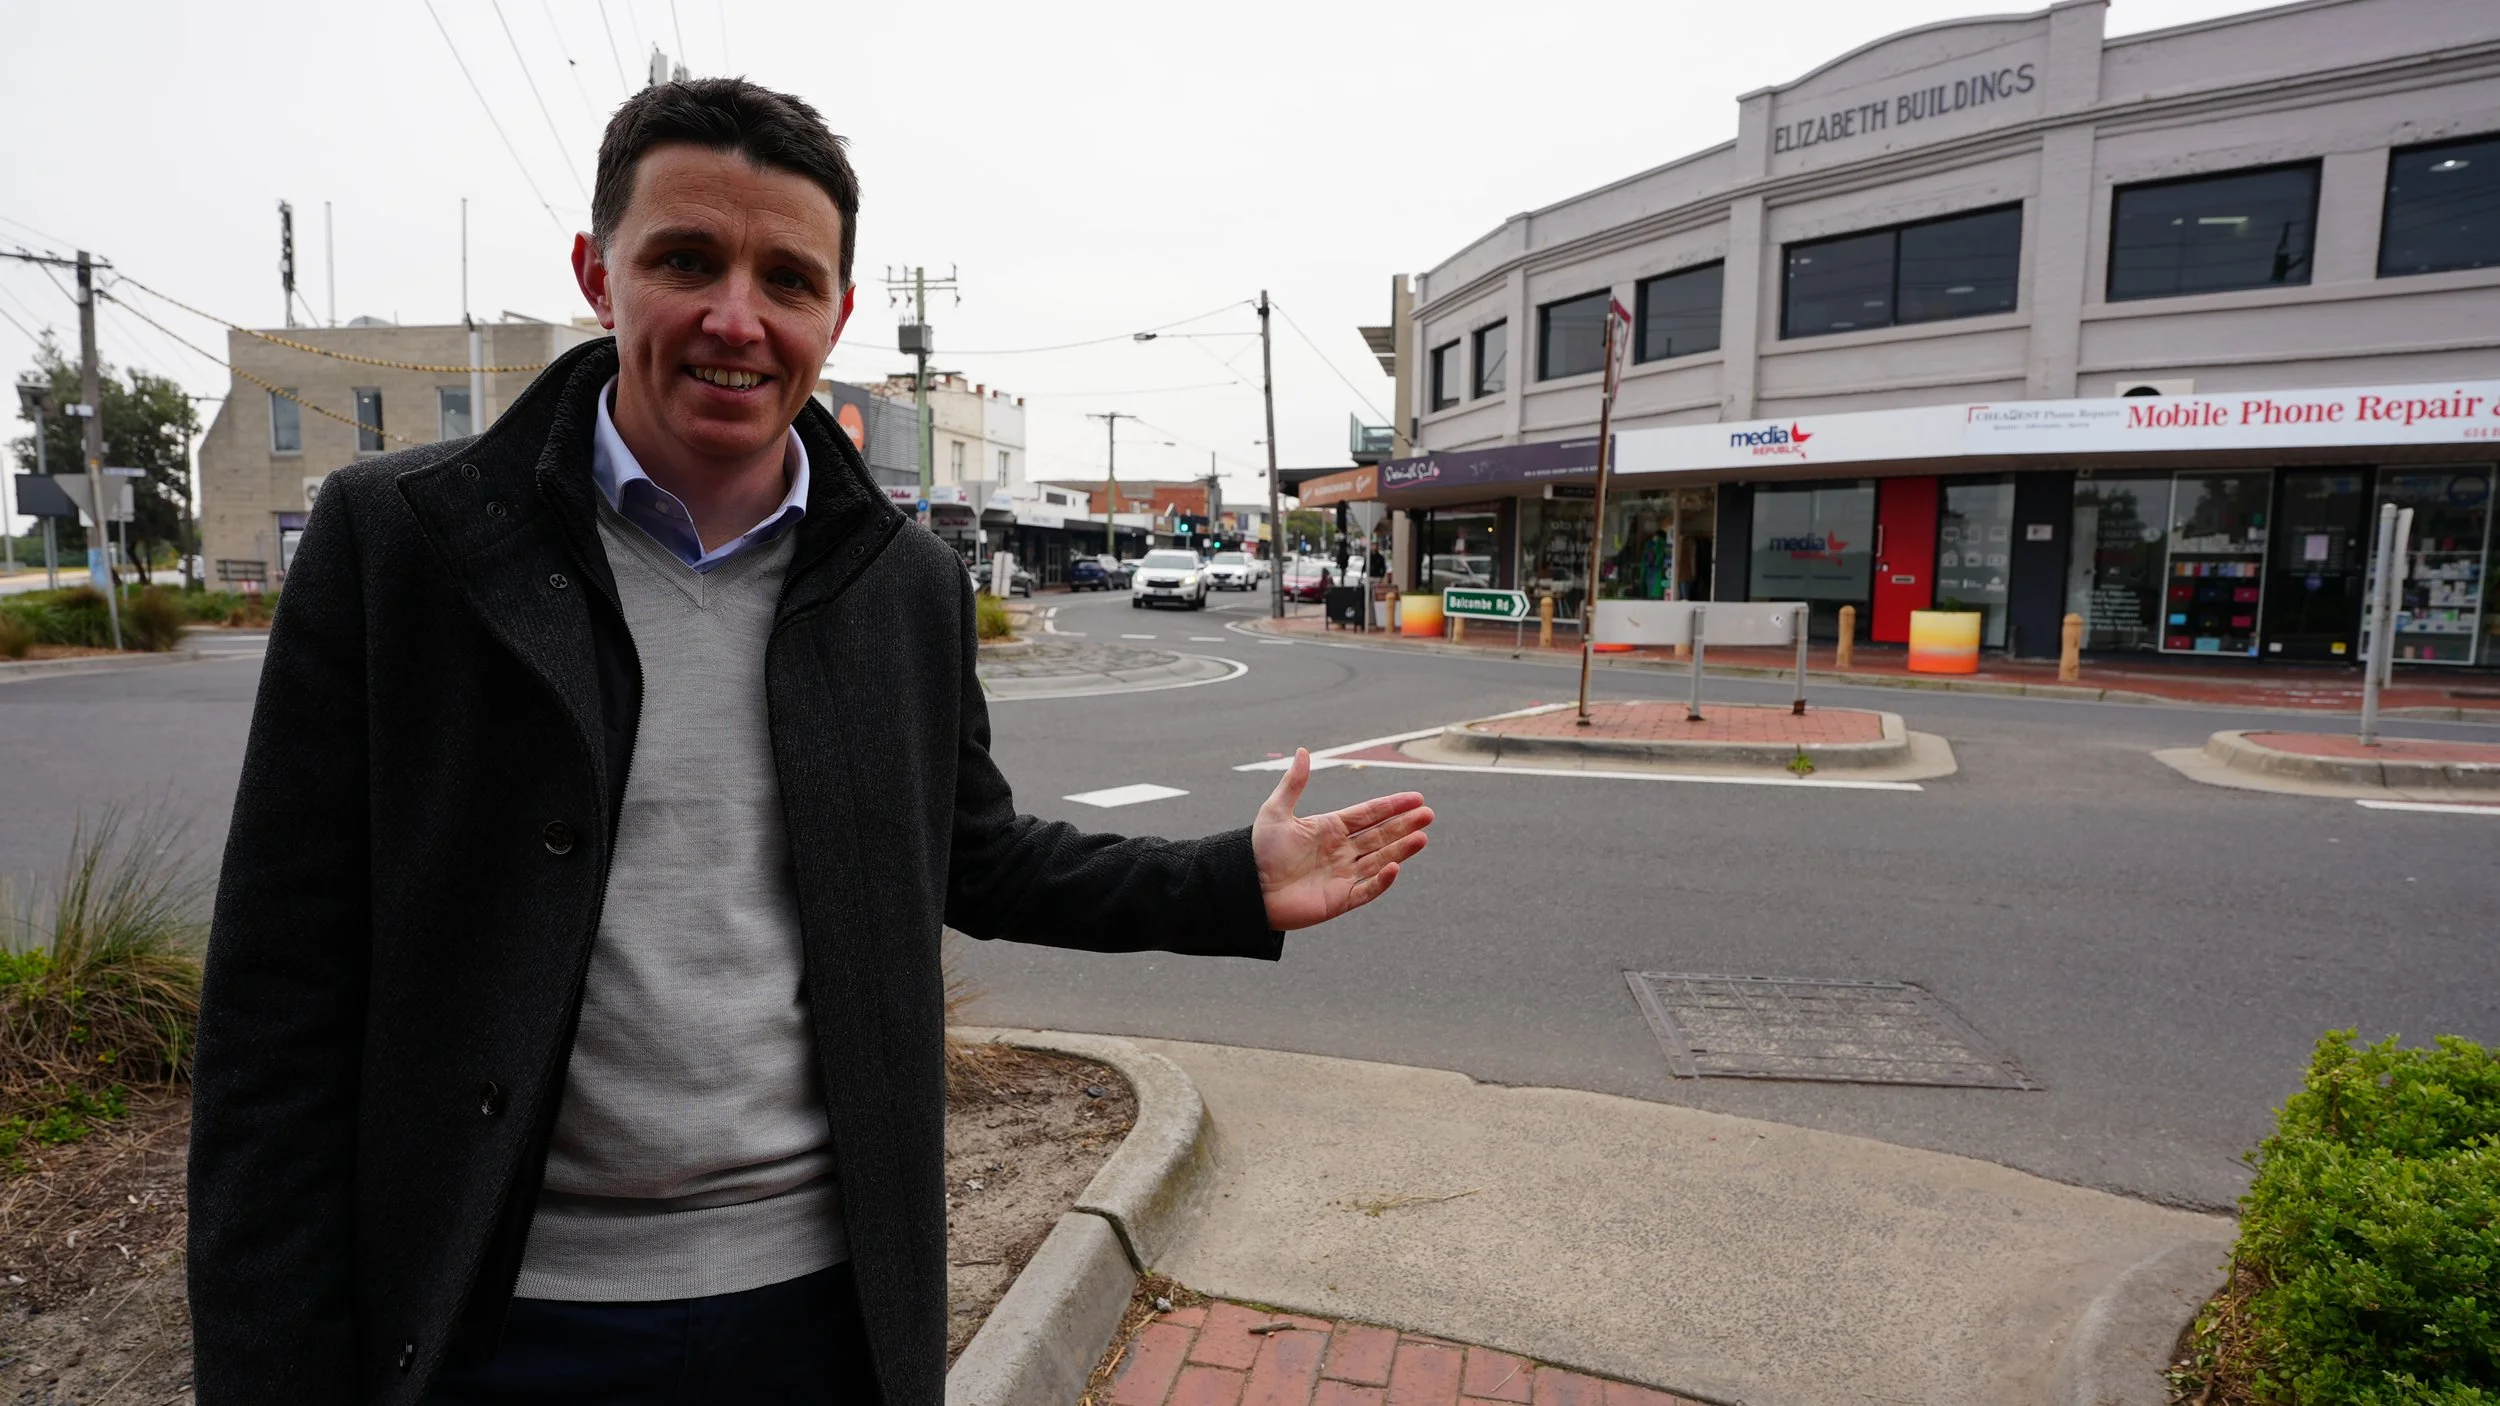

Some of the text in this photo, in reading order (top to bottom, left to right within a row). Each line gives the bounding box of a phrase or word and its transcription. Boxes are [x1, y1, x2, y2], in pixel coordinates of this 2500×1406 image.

[1774, 63, 2036, 155] ELIZABETH BUILDINGS
[2127, 401, 2228, 428] Mobile
[2240, 400, 2345, 426] Phone
[2355, 390, 2483, 426] Repair
[1730, 426, 1788, 447] media
[1770, 533, 1825, 552] media
[1449, 595, 1509, 611] Balcombe Rd
